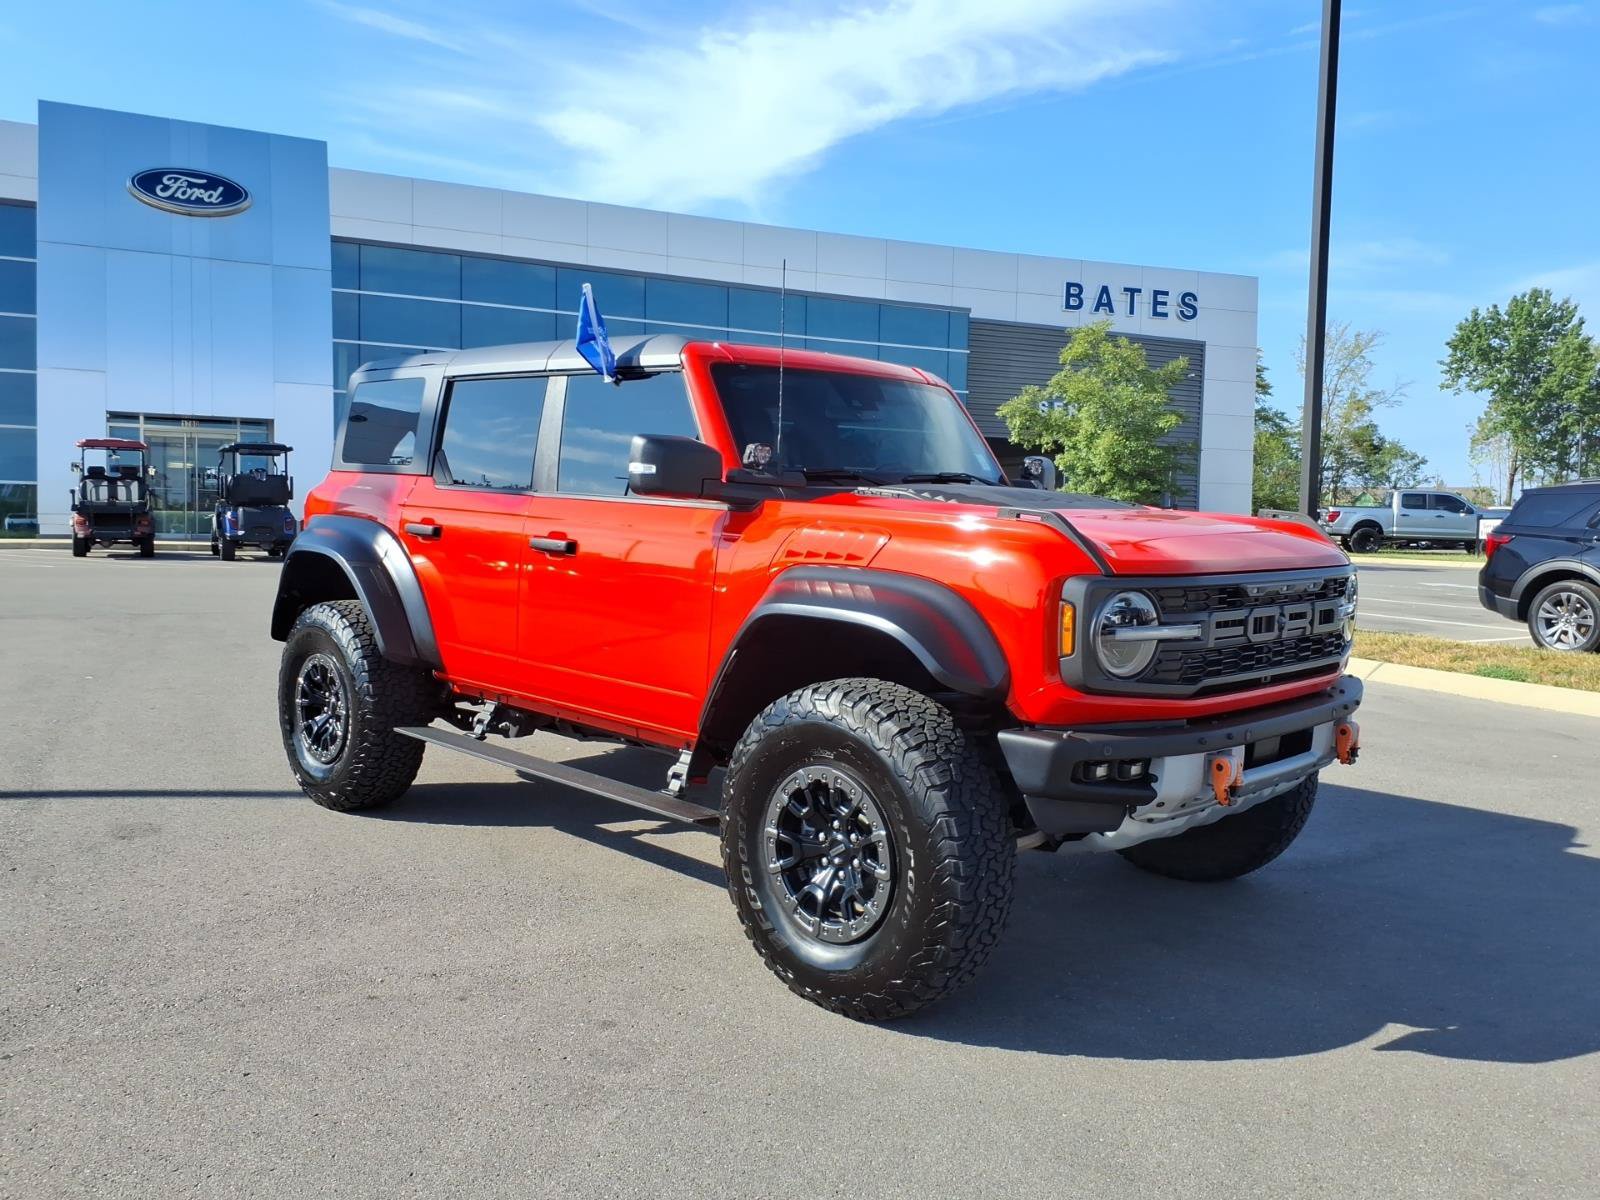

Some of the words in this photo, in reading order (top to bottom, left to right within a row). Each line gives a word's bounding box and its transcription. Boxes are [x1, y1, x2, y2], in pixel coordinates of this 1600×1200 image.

[155, 174, 225, 204] Ford
[1063, 281, 1199, 321] BATES
[1207, 600, 1340, 648] FORD
